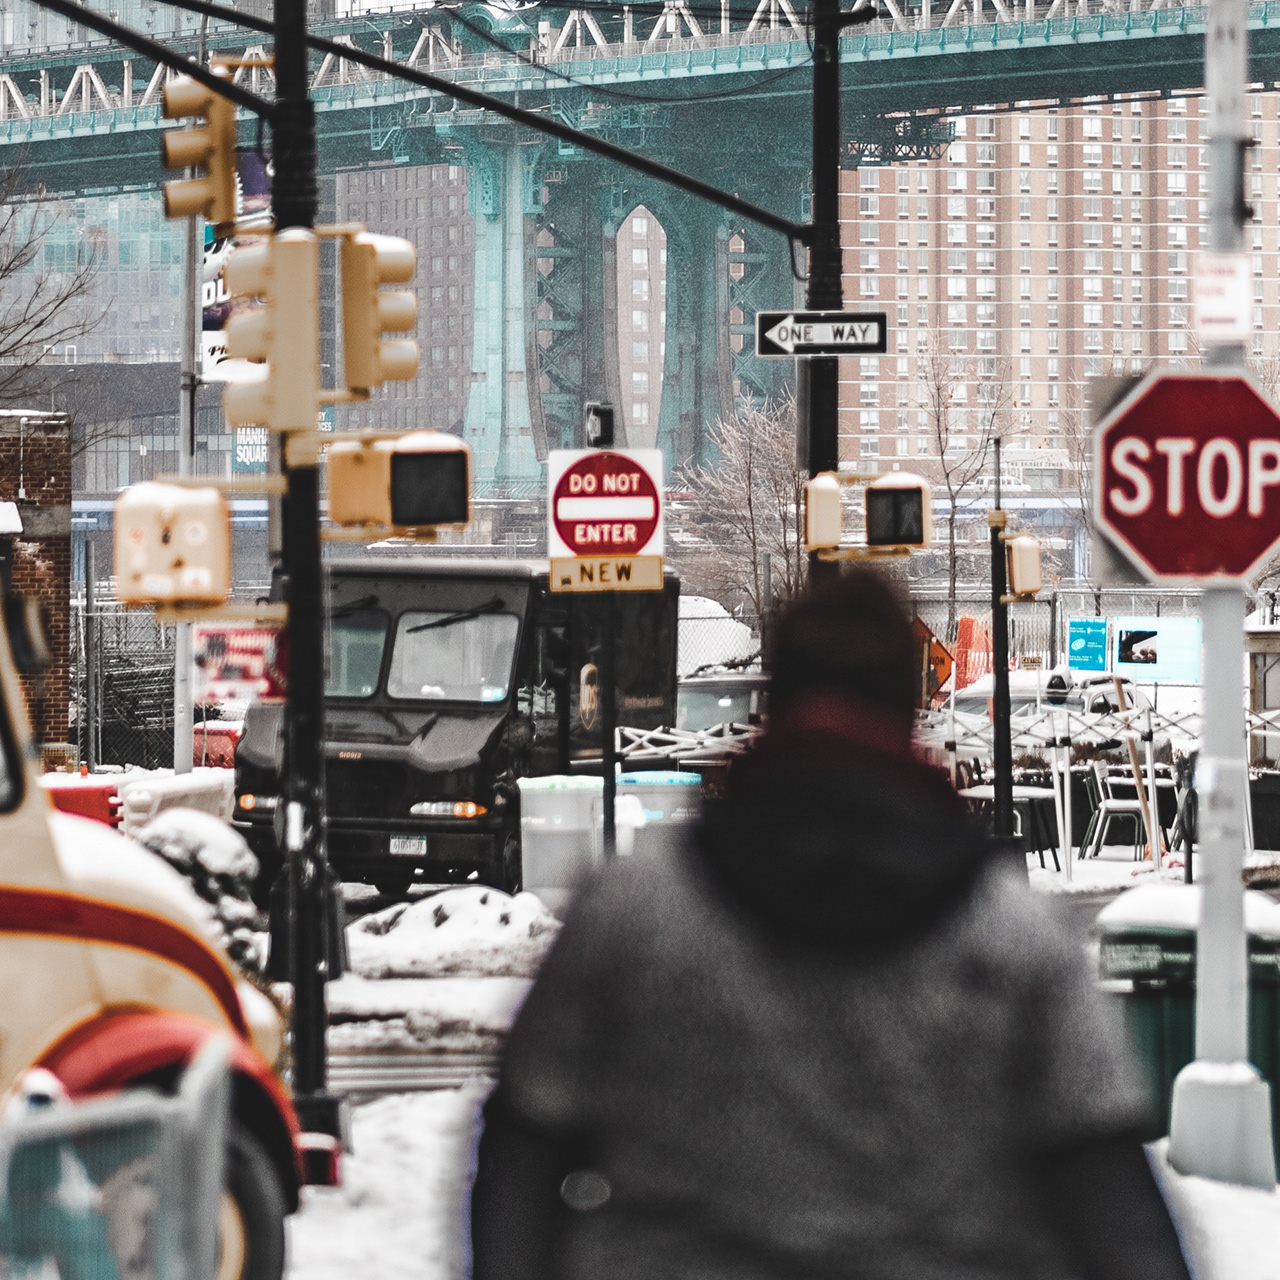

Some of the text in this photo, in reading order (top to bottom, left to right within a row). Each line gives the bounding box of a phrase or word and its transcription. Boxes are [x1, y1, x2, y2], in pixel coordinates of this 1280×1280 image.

[778, 324, 870, 342] ONE WAY
[236, 445, 269, 465] SQUAR
[569, 473, 640, 494] DO NOT
[574, 523, 638, 544] ENTER
[579, 562, 632, 583] NEW
